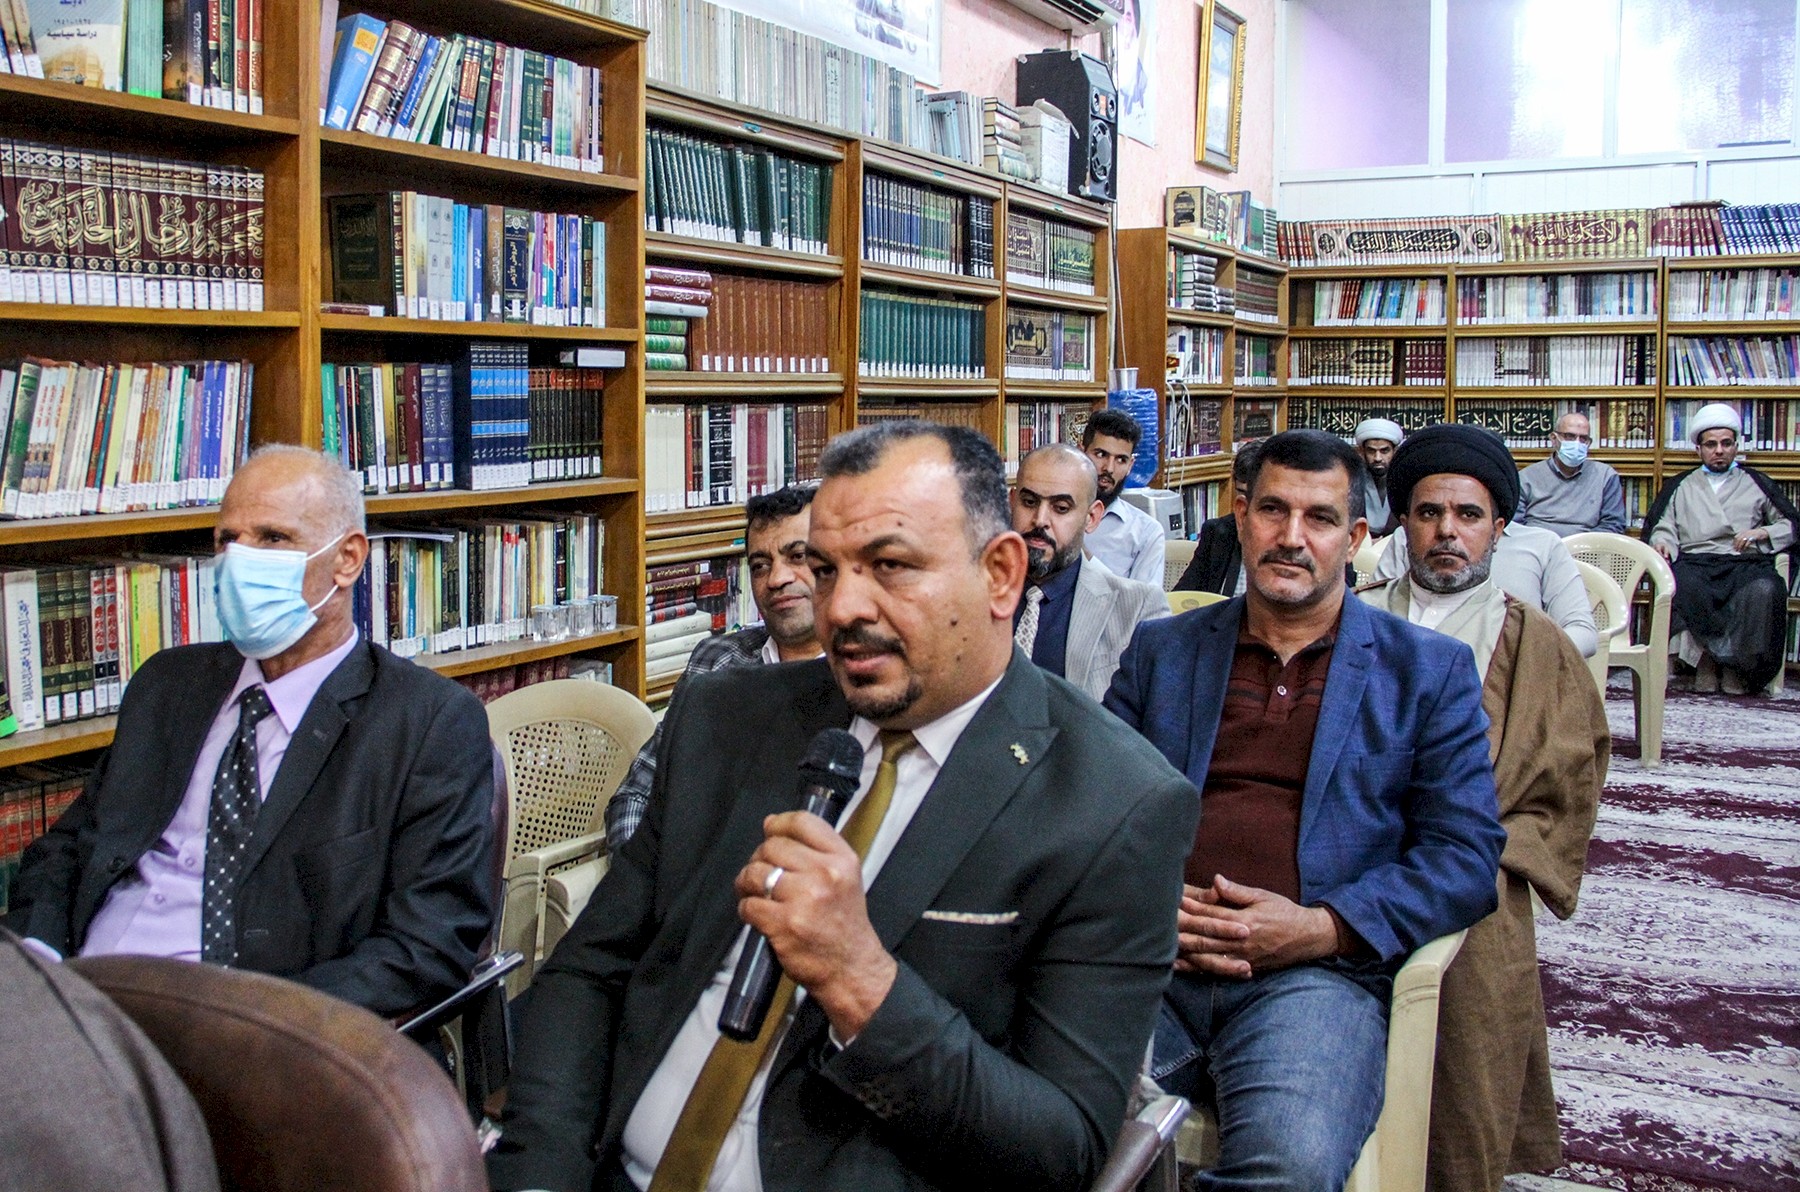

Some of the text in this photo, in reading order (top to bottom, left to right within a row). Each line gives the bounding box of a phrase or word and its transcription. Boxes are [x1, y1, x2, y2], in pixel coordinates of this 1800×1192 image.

[46, 28, 97, 40] دراسة سياسية
[508, 241, 518, 265] الروض
[1513, 411, 1551, 433] تاريخ
